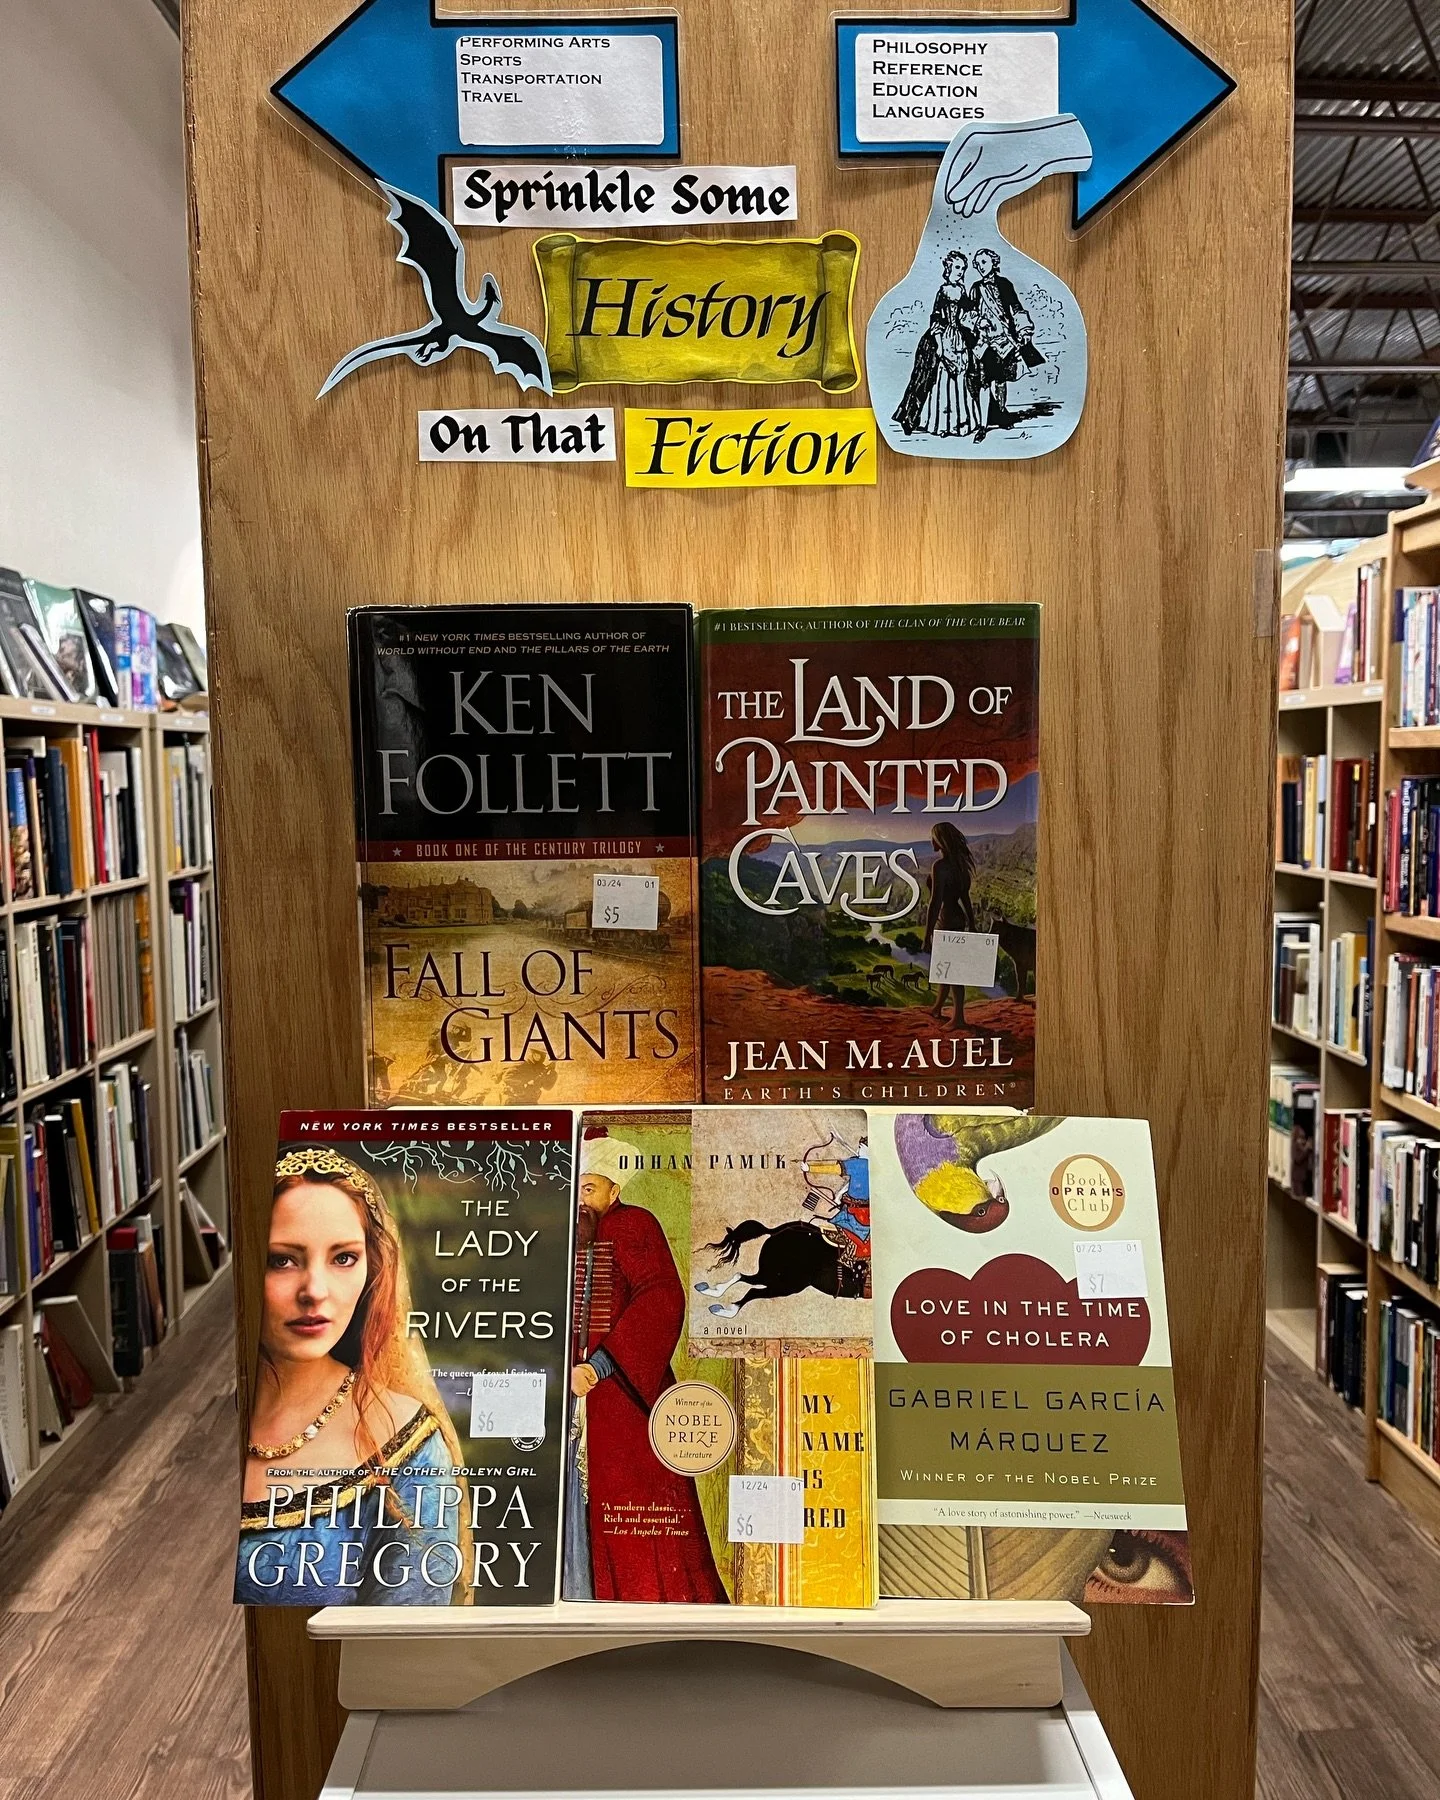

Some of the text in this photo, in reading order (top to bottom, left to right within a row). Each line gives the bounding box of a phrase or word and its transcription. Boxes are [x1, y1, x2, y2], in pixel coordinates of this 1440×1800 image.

[460, 37, 610, 48] PERFORMING ARTS
[873, 39, 988, 54] PHILOSOPHY
[460, 54, 522, 66] SPORTS
[873, 61, 983, 76] REFERENCE
[461, 72, 602, 84] TRANSPORTATION
[461, 90, 523, 102] TRAVEL
[873, 83, 978, 97] EDUCATION
[873, 104, 985, 119] LANGUAGES
[463, 169, 790, 223] Sprinkle Some
[566, 277, 832, 358] History
[430, 413, 606, 454] On That
[634, 417, 868, 477] Fiction
[714, 617, 1026, 632] #1 BESTSELLING AUTHOR OF THE CLAN OF THE CAVE BEAR
[399, 634, 410, 642] #1
[415, 634, 438, 642] NEW
[442, 633, 470, 641] YORK
[474, 633, 506, 641] TIMES
[508, 632, 581, 641] BESTSELLING
[584, 632, 629, 640] AUTHOR
[377, 645, 670, 656] WORLD WITHOUT END AND THE PILLARS OF THE EARTH
[449, 670, 597, 735] KEN
[717, 658, 1013, 747] THE LAND OF
[376, 750, 672, 815] FOLLETT
[714, 736, 1009, 826] PAINTED
[416, 841, 642, 857] BOOK ONE OF THE CENTURY TRILOGY
[728, 826, 920, 923] CAVES
[596, 879, 655, 889] 03/24 01
[604, 906, 620, 924] $5
[942, 935, 995, 946] 11/25 01
[383, 943, 593, 1000] FALL OF
[935, 960, 951, 979] $7
[440, 1007, 680, 1064] GIANTS
[723, 1037, 1013, 1080] JEAN M. AUEL
[724, 1086, 842, 1100] EARTH'S
[299, 1122, 553, 1132] NEW YORK TIMES BESTSELLER
[619, 1154, 786, 1170] ORHAN PAMUK
[1066, 1172, 1107, 1187] Book
[1051, 1186, 1124, 1197] OPRAH'S
[461, 1199, 510, 1217] THE
[1067, 1198, 1110, 1212] Club
[434, 1229, 539, 1257] LADY
[1076, 1243, 1137, 1253] 07/23 01
[441, 1278, 521, 1293] OF THE
[1089, 1273, 1104, 1293] $7
[904, 1298, 1142, 1319] LOVE IN THE TIME
[404, 1310, 554, 1340] RIVERS
[703, 1324, 748, 1335] a novel
[940, 1329, 1110, 1348] OF CHOLERA
[482, 1378, 542, 1388] 06/25 01
[675, 1397, 700, 1406] Winner
[801, 1394, 835, 1414] MY
[888, 1388, 1165, 1412] GABRIEL GARCÍA
[477, 1411, 494, 1432] $6
[665, 1414, 723, 1427] NOBEL
[668, 1431, 718, 1448] PRIZE
[801, 1431, 864, 1452] NAME
[950, 1427, 1109, 1453] MÁRQUEZ
[679, 1450, 713, 1459] Literature
[267, 1468, 294, 1476] FROM
[373, 1466, 399, 1476] THE
[402, 1466, 447, 1476] OTHER
[450, 1466, 502, 1476] BOLEYN
[506, 1466, 537, 1476] GIRL
[803, 1469, 823, 1489] IS
[900, 1469, 1158, 1486] WINNER OF THE NOBEL PRIZE
[741, 1481, 801, 1491] 12/24 01
[264, 1484, 534, 1530] PHILIPPA
[613, 1501, 645, 1511] modern
[948, 1507, 966, 1517] love
[967, 1510, 987, 1520] story
[989, 1508, 999, 1518] of
[1000, 1509, 1047, 1520] astonishing
[603, 1512, 623, 1523] Rich
[624, 1513, 641, 1523] and
[736, 1513, 753, 1537] $6
[803, 1507, 846, 1528] RED
[630, 1525, 662, 1537] Angeles
[665, 1526, 690, 1536] Times
[248, 1541, 542, 1588] GREGORY
